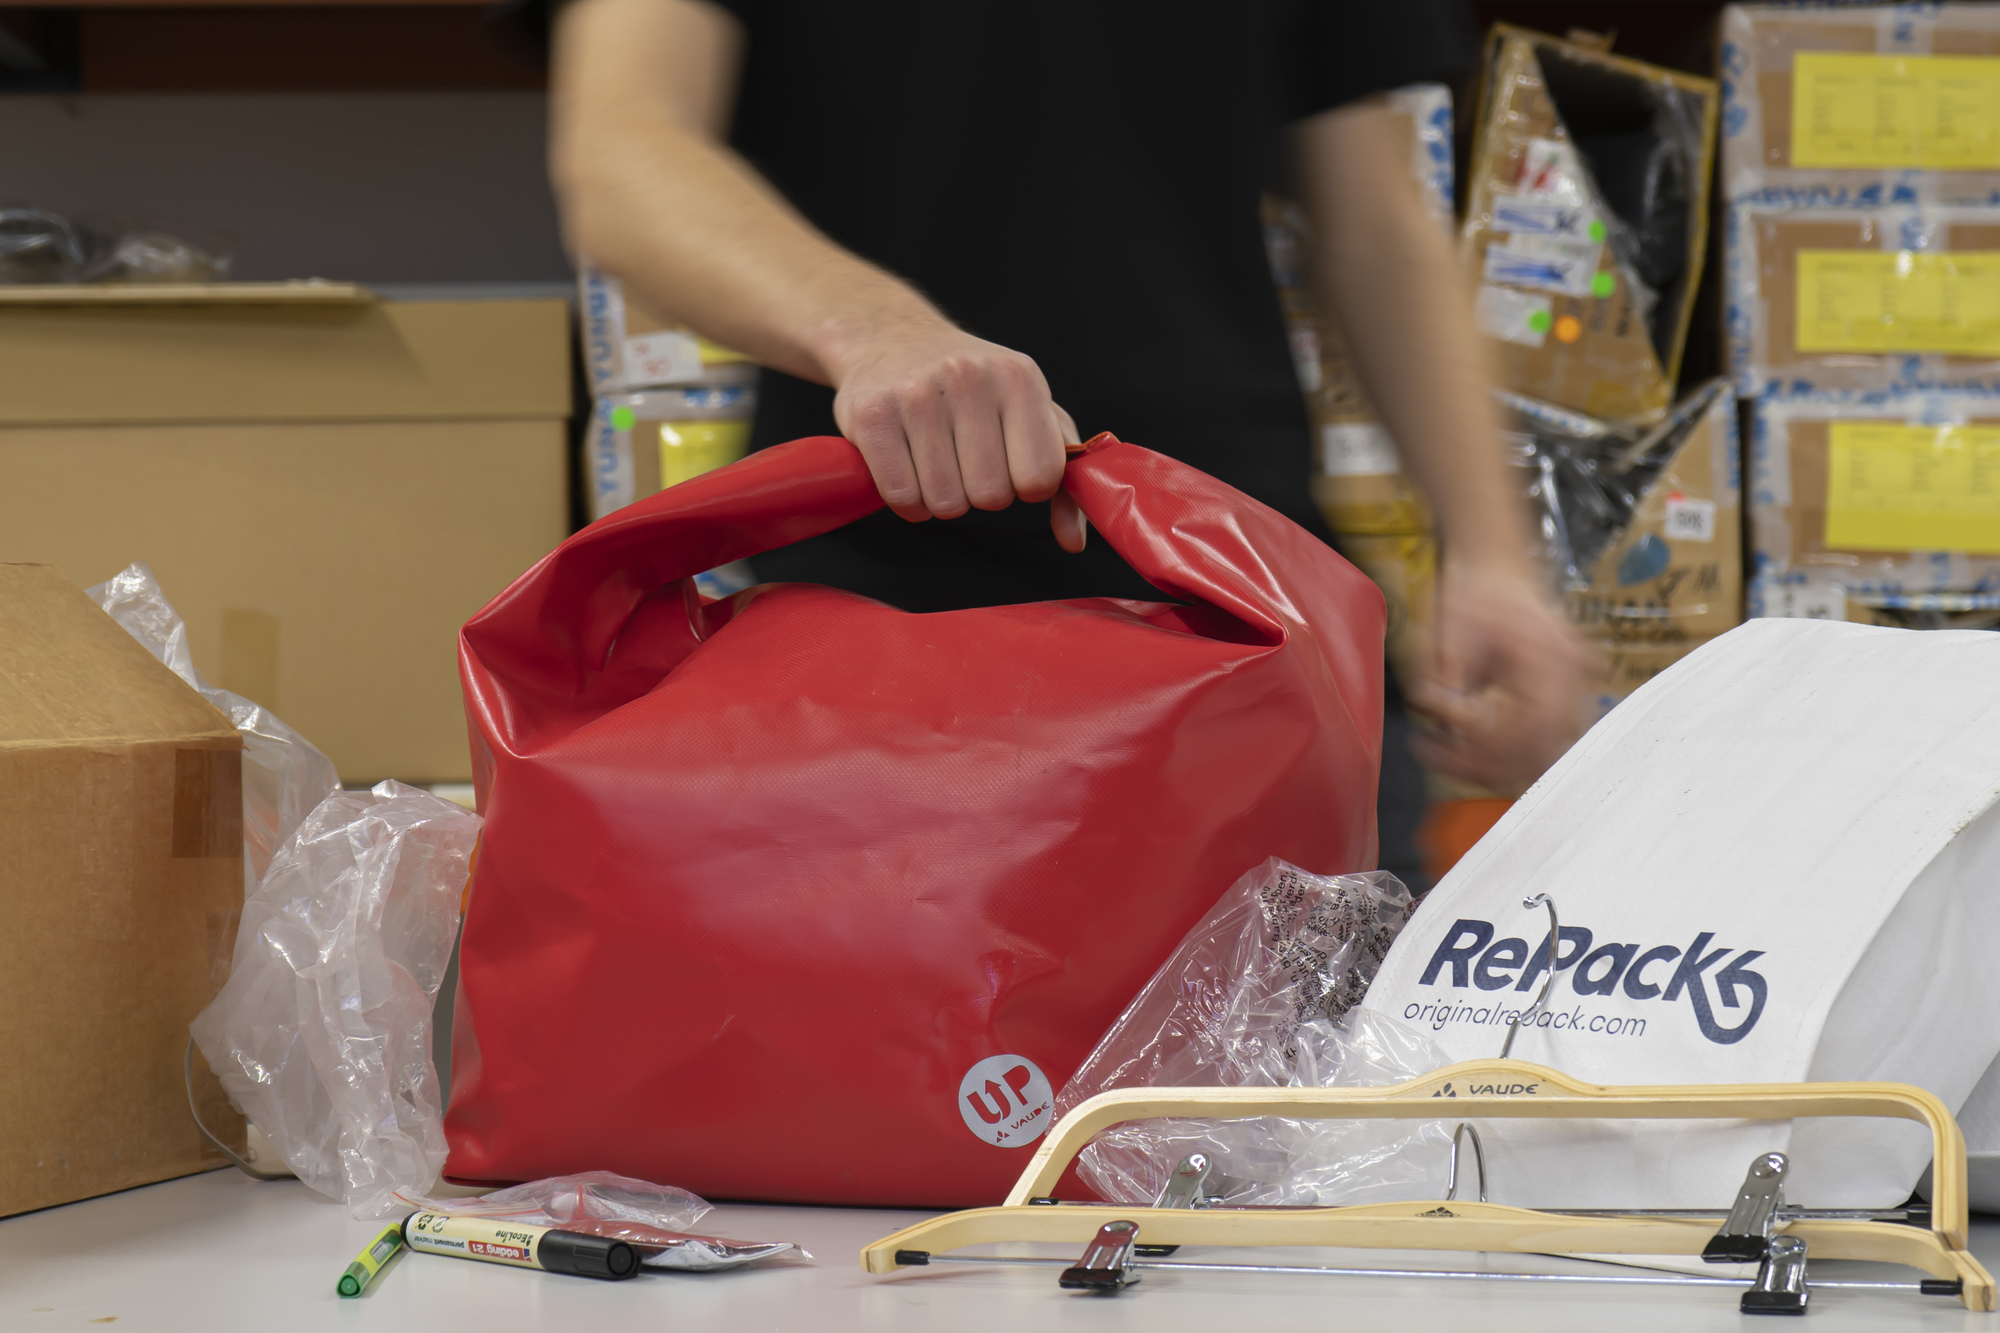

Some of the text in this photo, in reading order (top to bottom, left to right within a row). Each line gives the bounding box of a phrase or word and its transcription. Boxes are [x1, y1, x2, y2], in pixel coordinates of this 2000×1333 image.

[966, 1064, 1031, 1125] UP
[1469, 1083, 1539, 1096] VAUDE
[1010, 1101, 1050, 1130] VAUDE
[433, 1239, 465, 1249] permanent
[472, 1243, 521, 1258] edding 21
